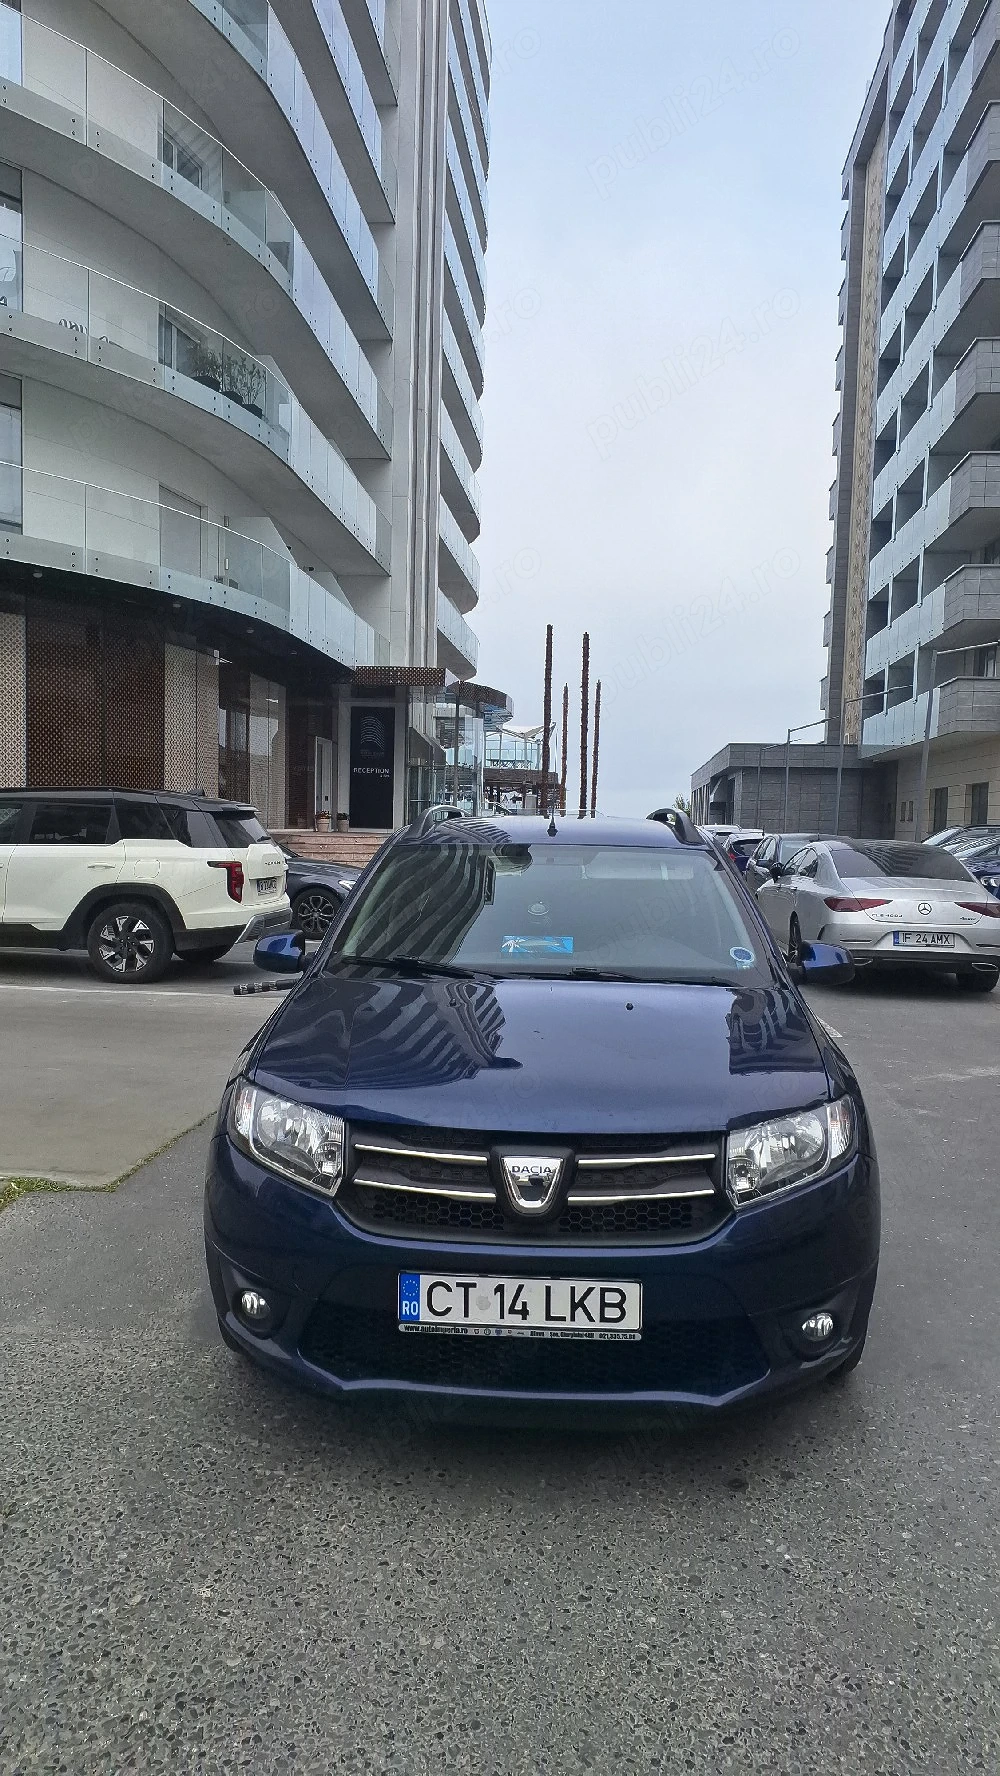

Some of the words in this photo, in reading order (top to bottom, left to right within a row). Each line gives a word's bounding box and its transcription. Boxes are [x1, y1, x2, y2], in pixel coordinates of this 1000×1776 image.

[902, 932, 912, 943] IF
[915, 933, 928, 944] 24
[930, 934, 951, 945] AMX
[511, 1165, 553, 1174] DACIA
[402, 1300, 419, 1316] RO
[426, 1280, 477, 1318] CT
[493, 1283, 530, 1321] 14
[545, 1284, 627, 1324] LKB
